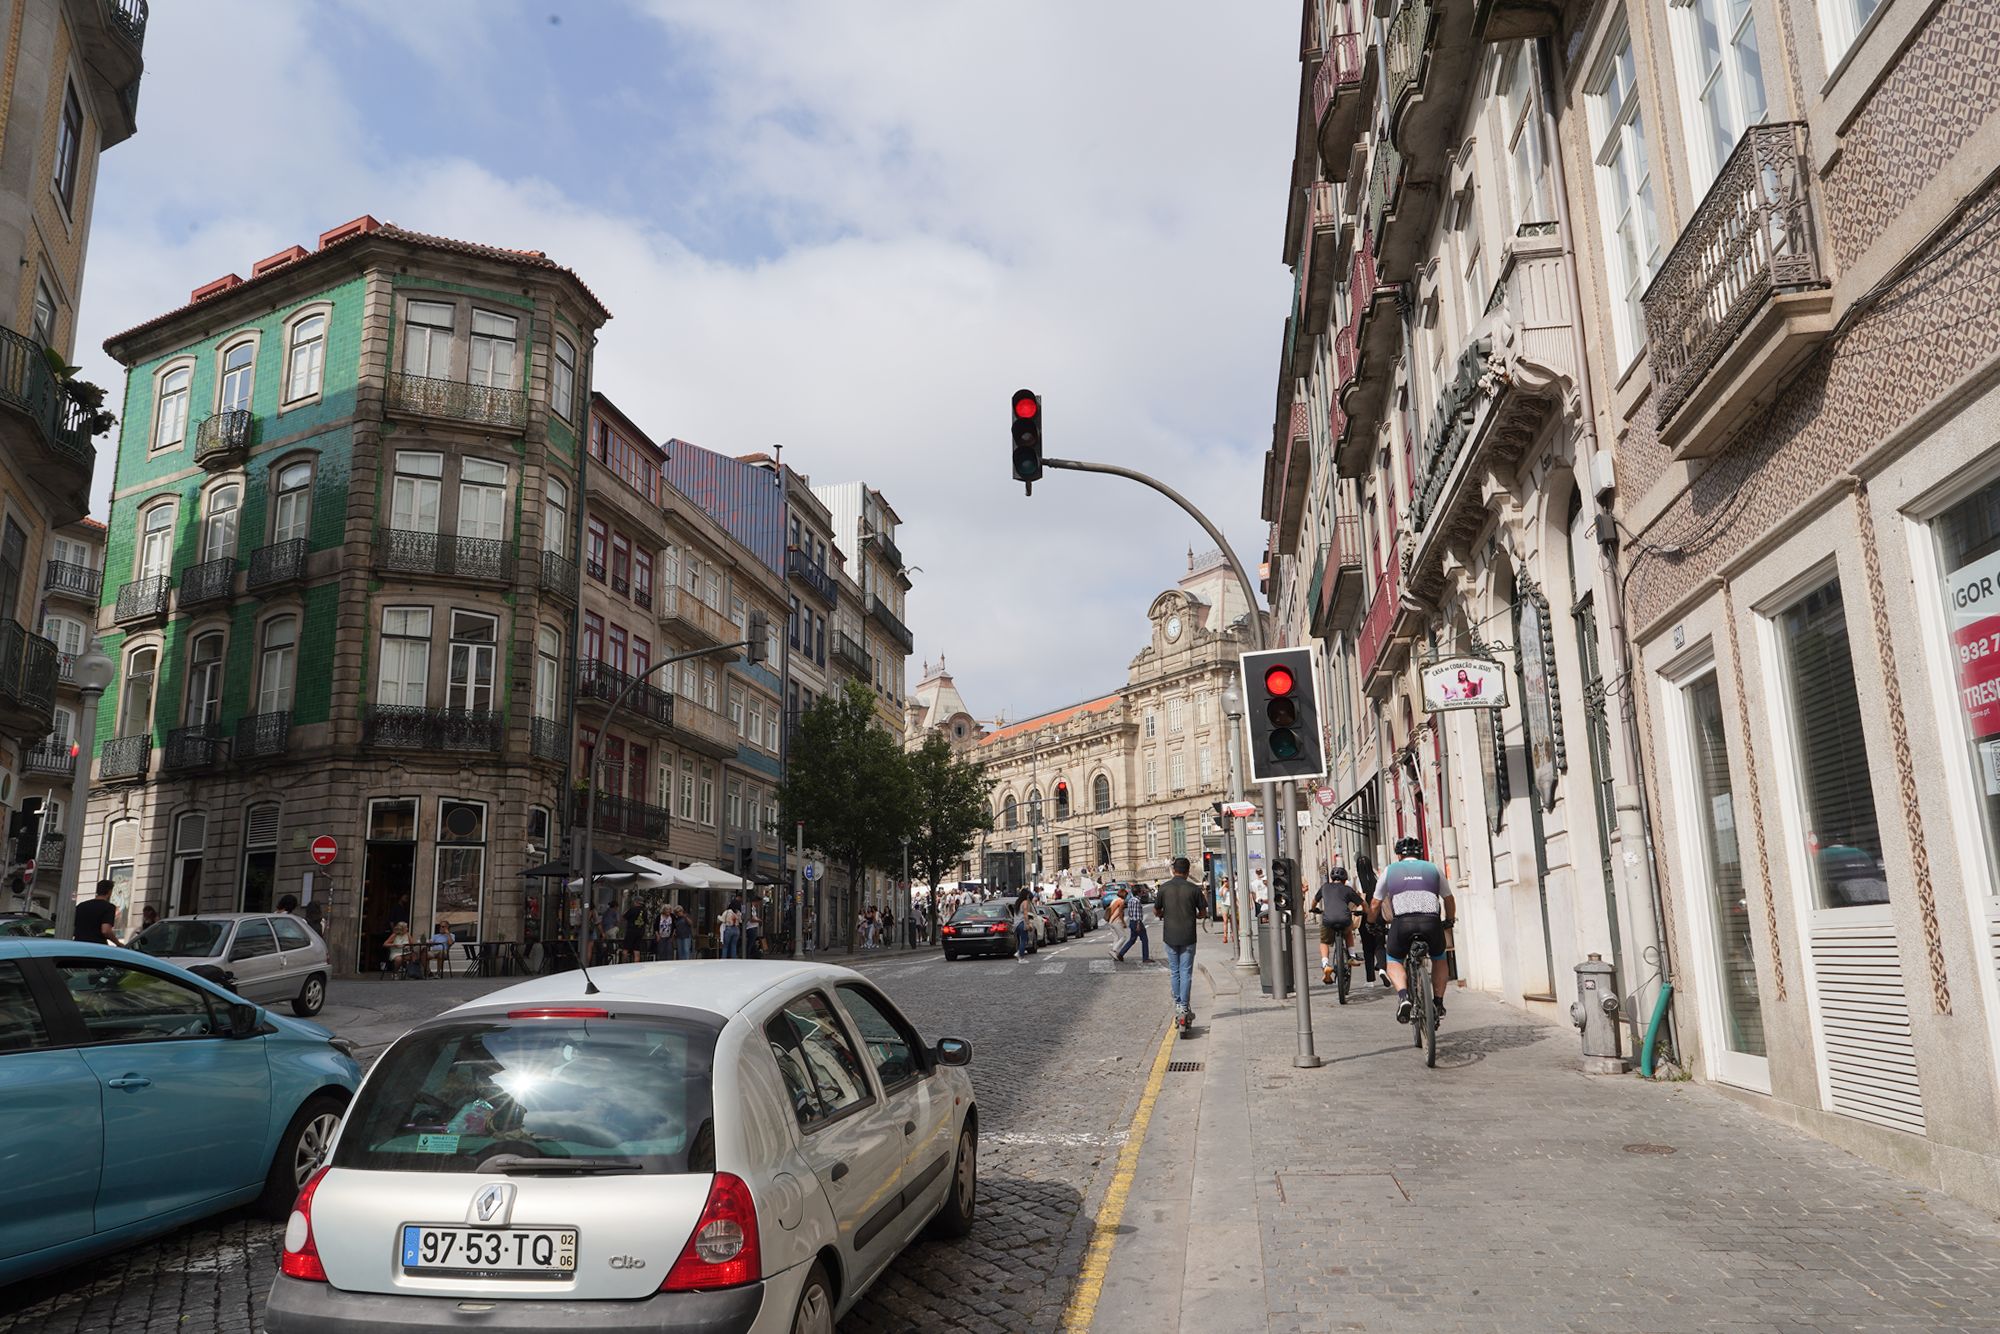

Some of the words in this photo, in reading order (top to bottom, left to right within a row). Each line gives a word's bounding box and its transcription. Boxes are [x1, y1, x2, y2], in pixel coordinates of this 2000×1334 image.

[1952, 577, 1994, 610] IGOR
[1960, 638, 1990, 664] 932
[561, 1234, 573, 1245] 02
[407, 1251, 414, 1259] P
[560, 1255, 573, 1266] 06
[608, 1253, 646, 1269] Clio
